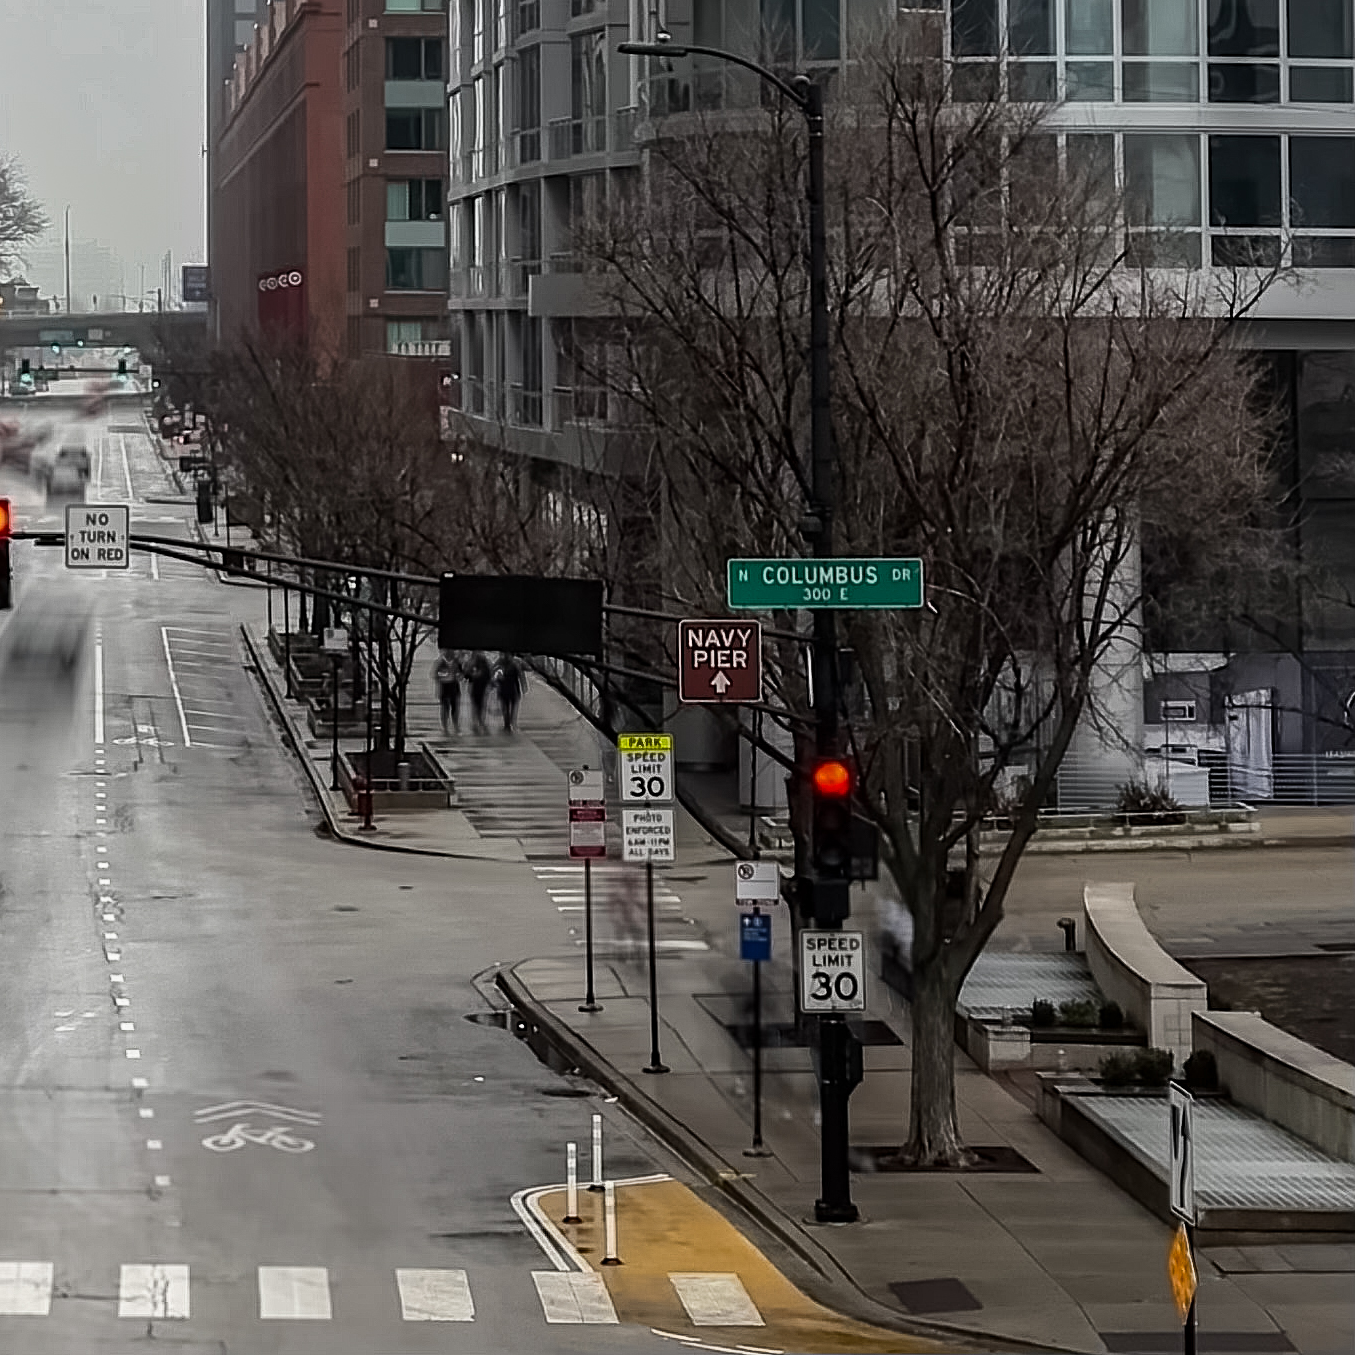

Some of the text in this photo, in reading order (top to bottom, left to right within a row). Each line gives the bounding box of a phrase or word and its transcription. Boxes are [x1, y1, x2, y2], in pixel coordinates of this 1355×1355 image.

[86, 513, 109, 526] NO
[78, 530, 116, 543] TURN
[71, 547, 124, 561] ON RED
[739, 566, 911, 585] N COLUMBUS DR
[803, 587, 848, 601] 300 E
[688, 629, 751, 647] NAVY
[694, 650, 747, 668] PIER
[628, 737, 662, 747] PARK
[627, 752, 666, 762] SPEED
[631, 764, 663, 774] LIMIT
[629, 776, 665, 798] 30
[633, 813, 663, 823] PHOTO
[806, 937, 861, 951] SPEED
[812, 954, 853, 967] LIMIT
[810, 971, 859, 1001] 30
